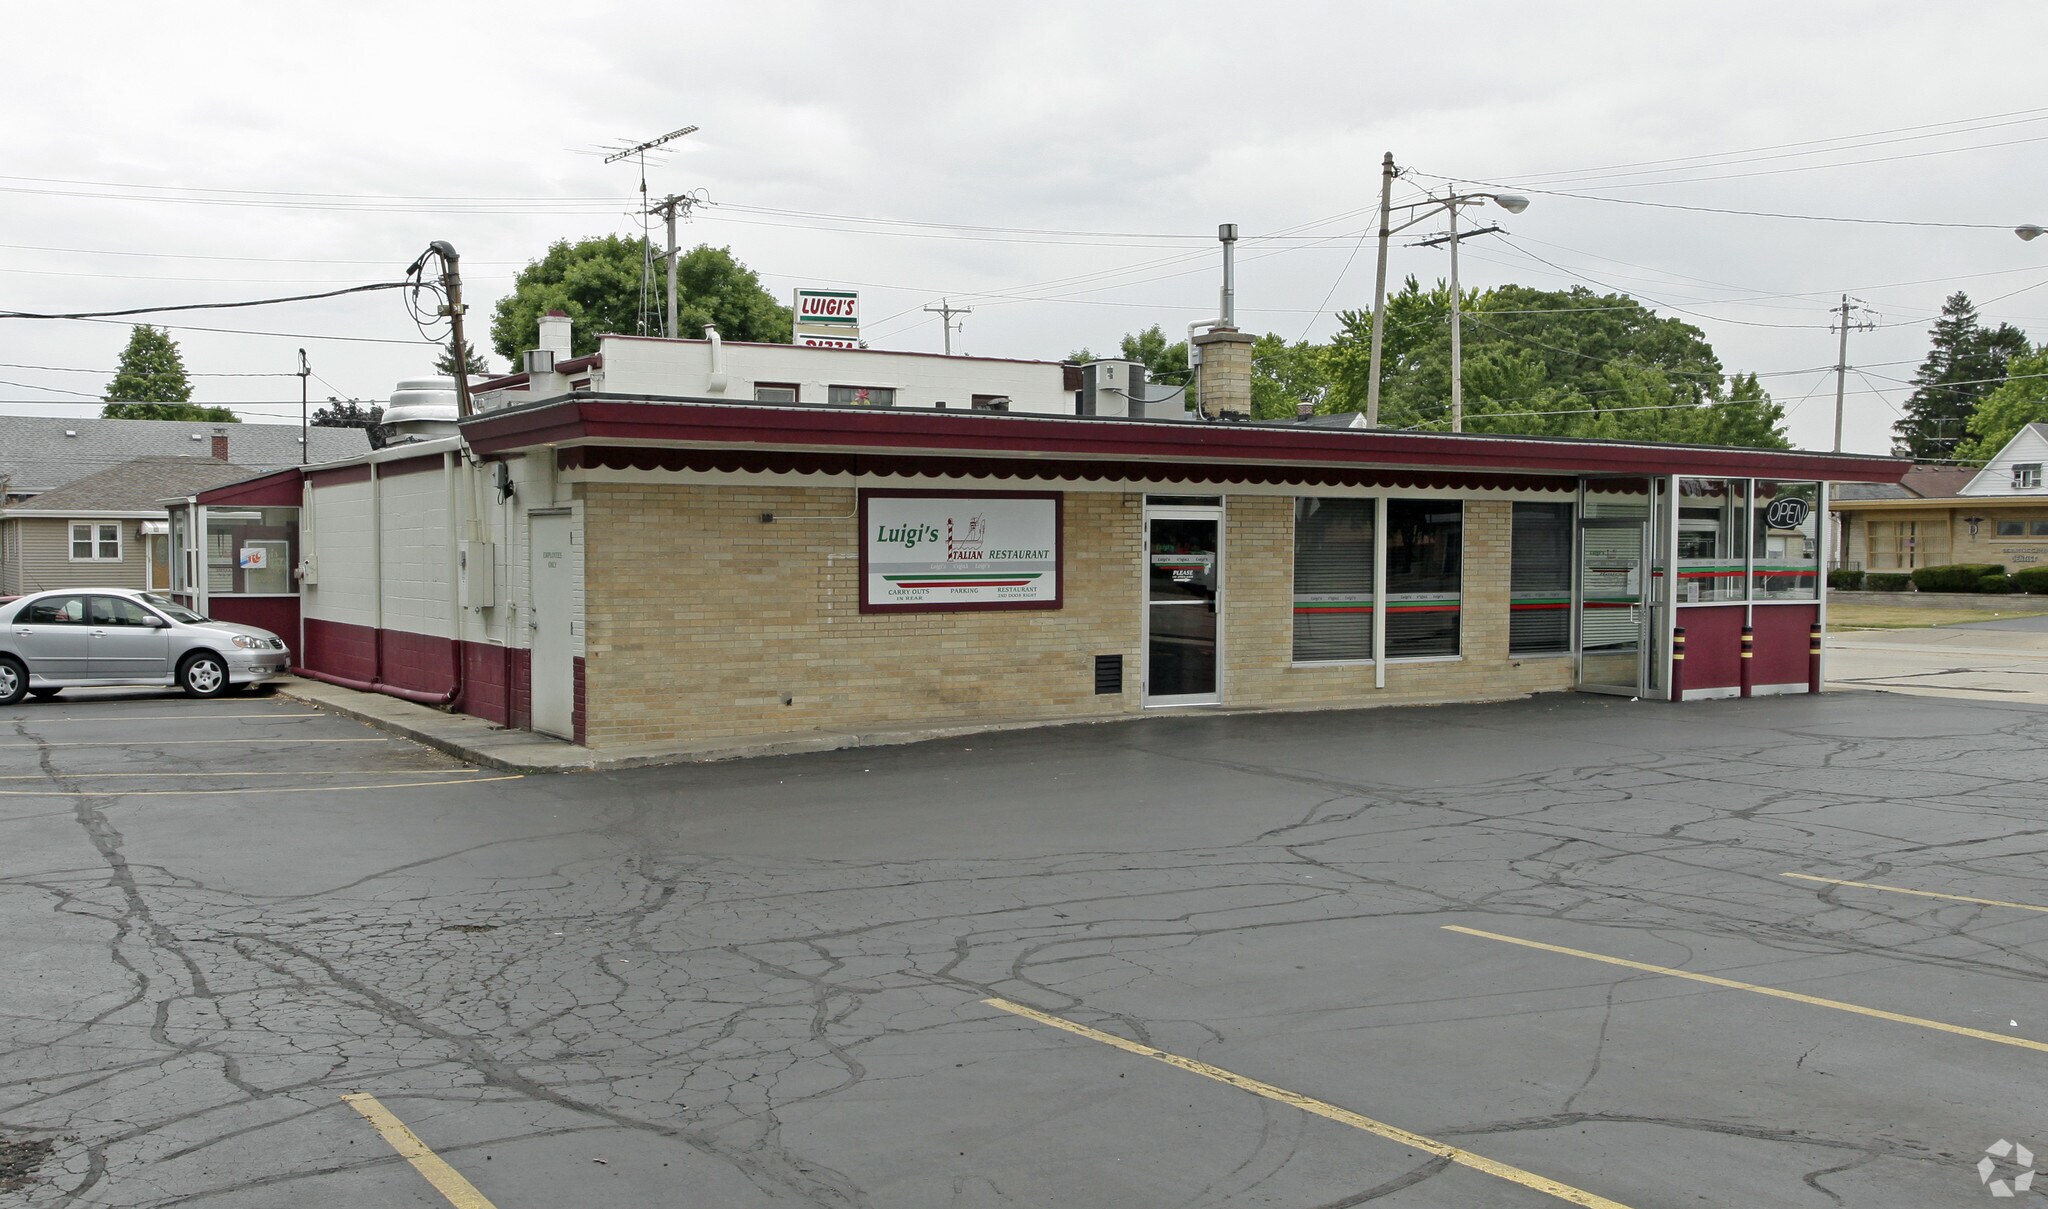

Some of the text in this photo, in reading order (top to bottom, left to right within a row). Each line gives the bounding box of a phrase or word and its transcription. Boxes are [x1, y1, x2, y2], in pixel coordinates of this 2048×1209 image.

[802, 298, 855, 315] LUIGI'S
[1770, 502, 1805, 524] OPEN
[877, 523, 939, 548] Luigi's
[989, 549, 1050, 560] RESTAURANT
